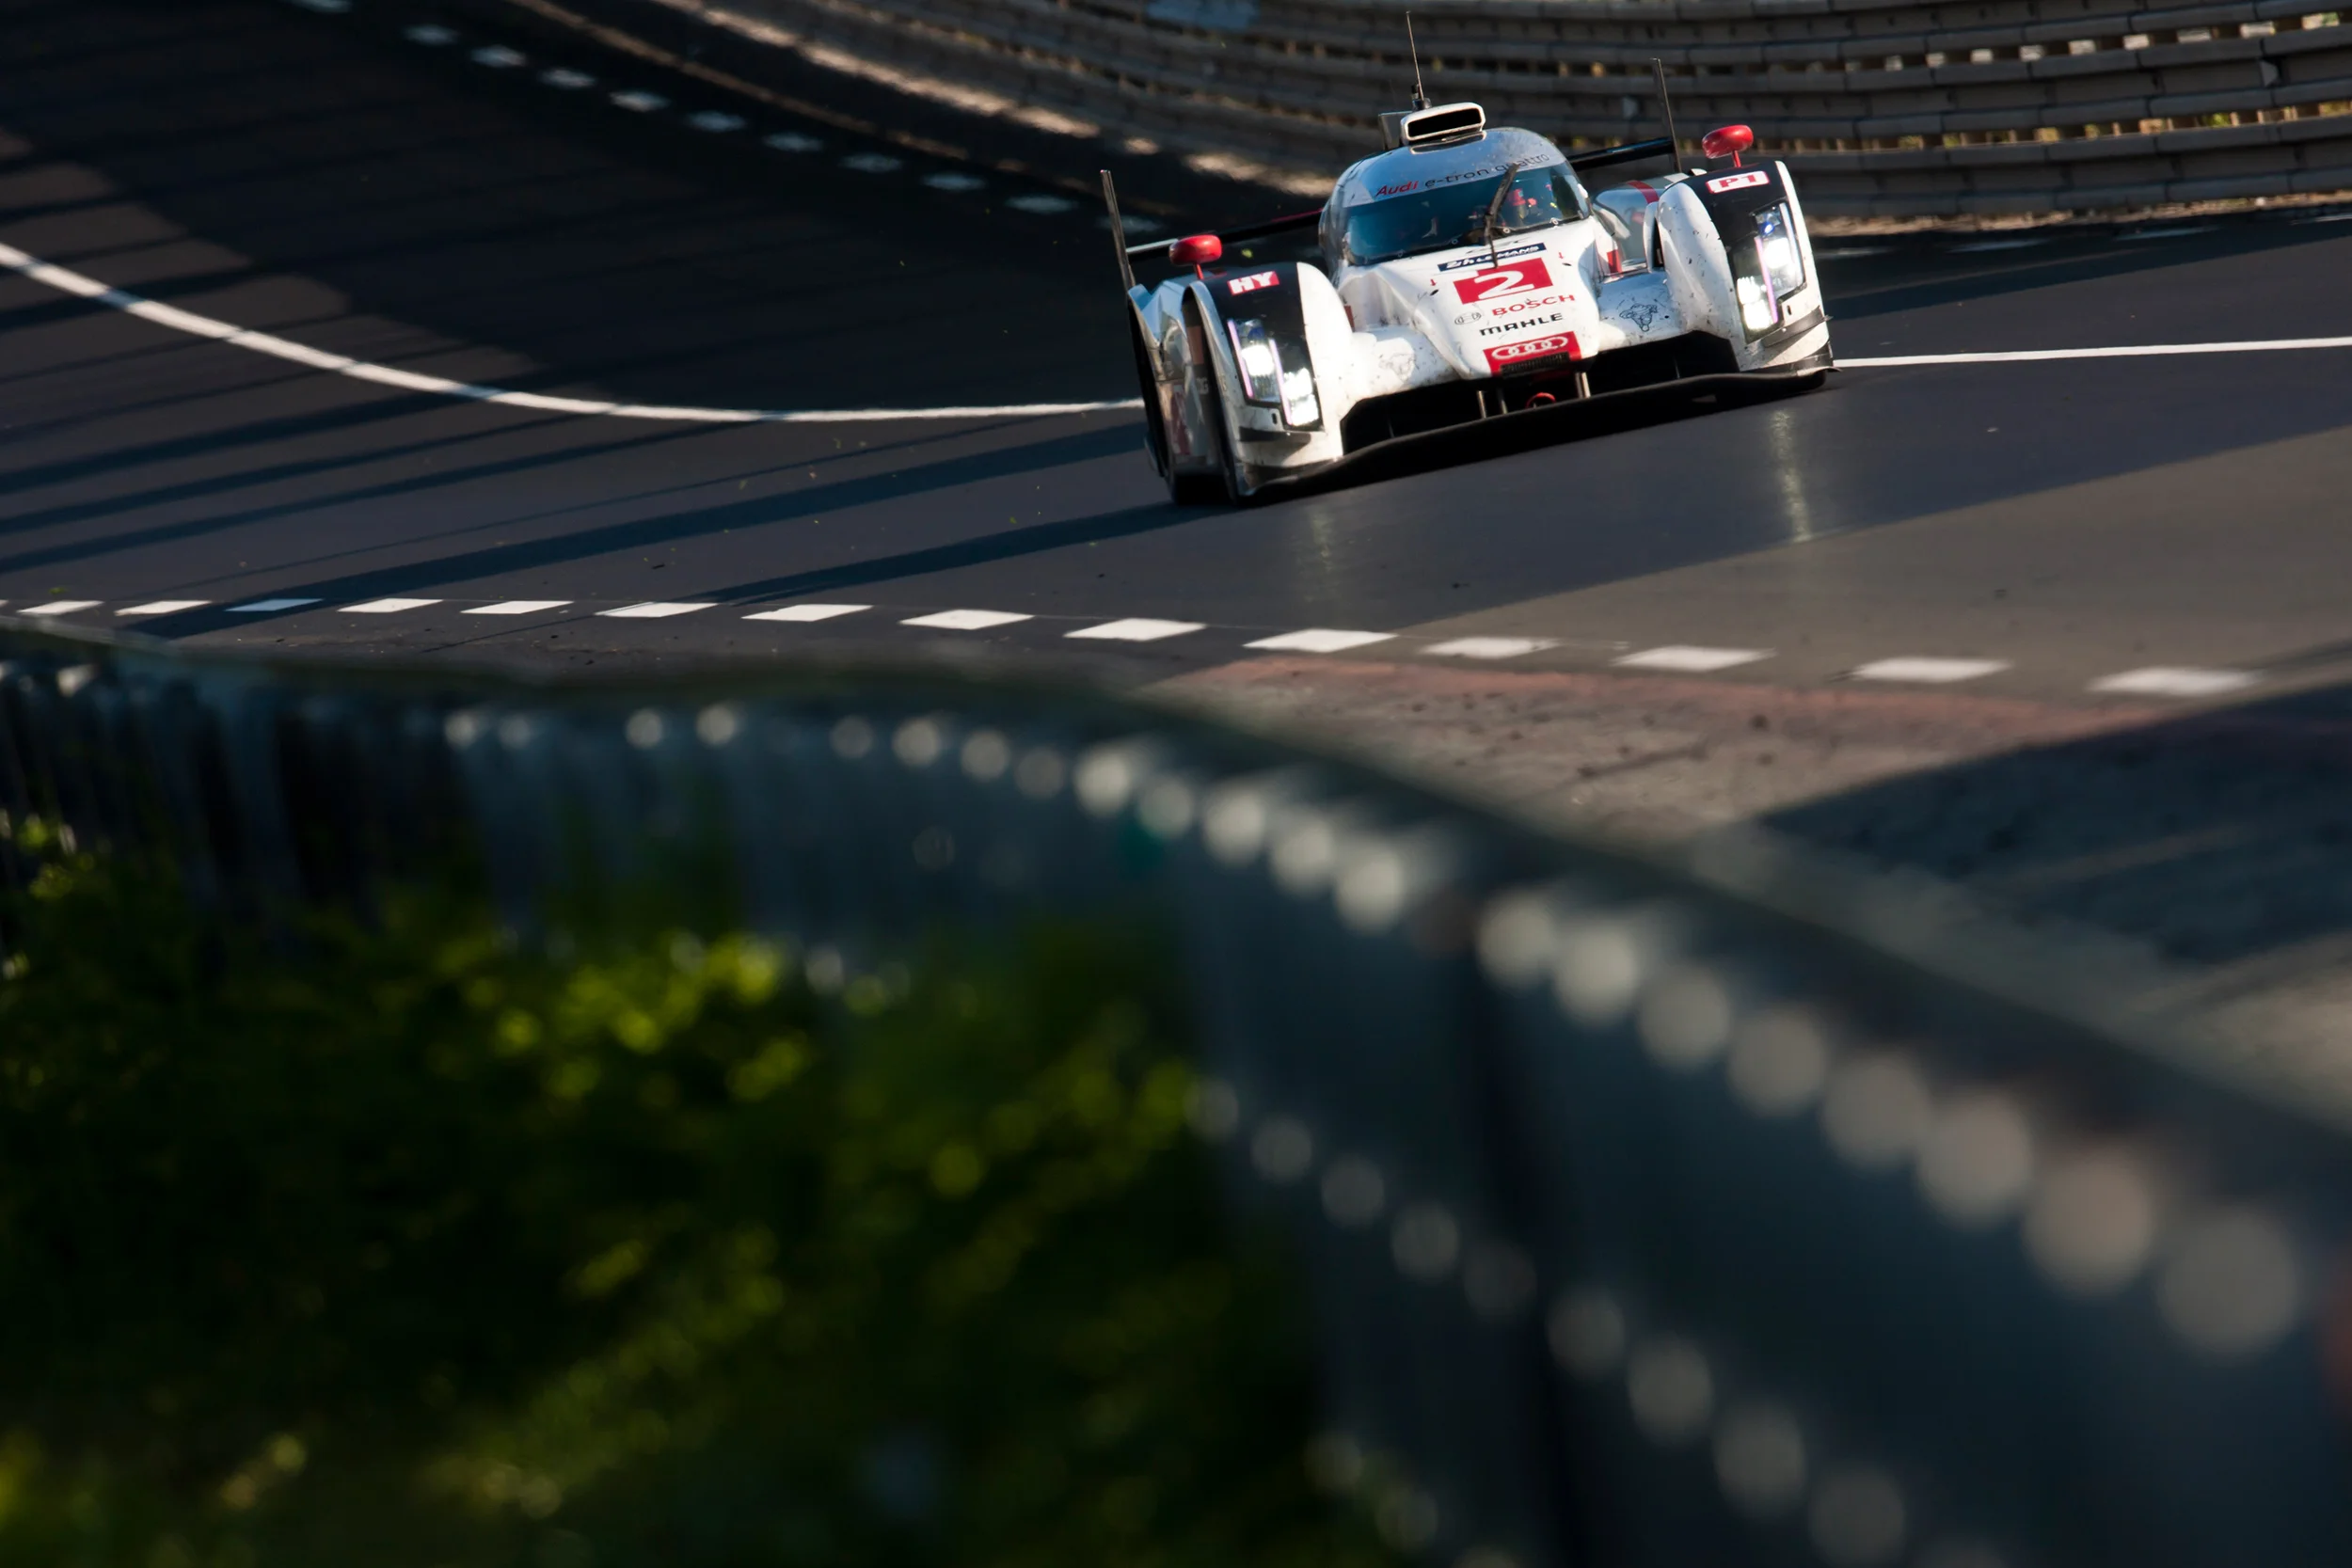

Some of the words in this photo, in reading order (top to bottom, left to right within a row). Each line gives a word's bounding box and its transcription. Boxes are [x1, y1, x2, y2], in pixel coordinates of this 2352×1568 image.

[1375, 180, 1419, 198] Audi
[1424, 168, 1489, 188] e-tron
[1720, 174, 1758, 188] P1
[1229, 271, 1276, 294] HY
[1474, 270, 1535, 300] 2
[1491, 294, 1576, 316] BOSCH
[1479, 312, 1564, 337] MAHLE
